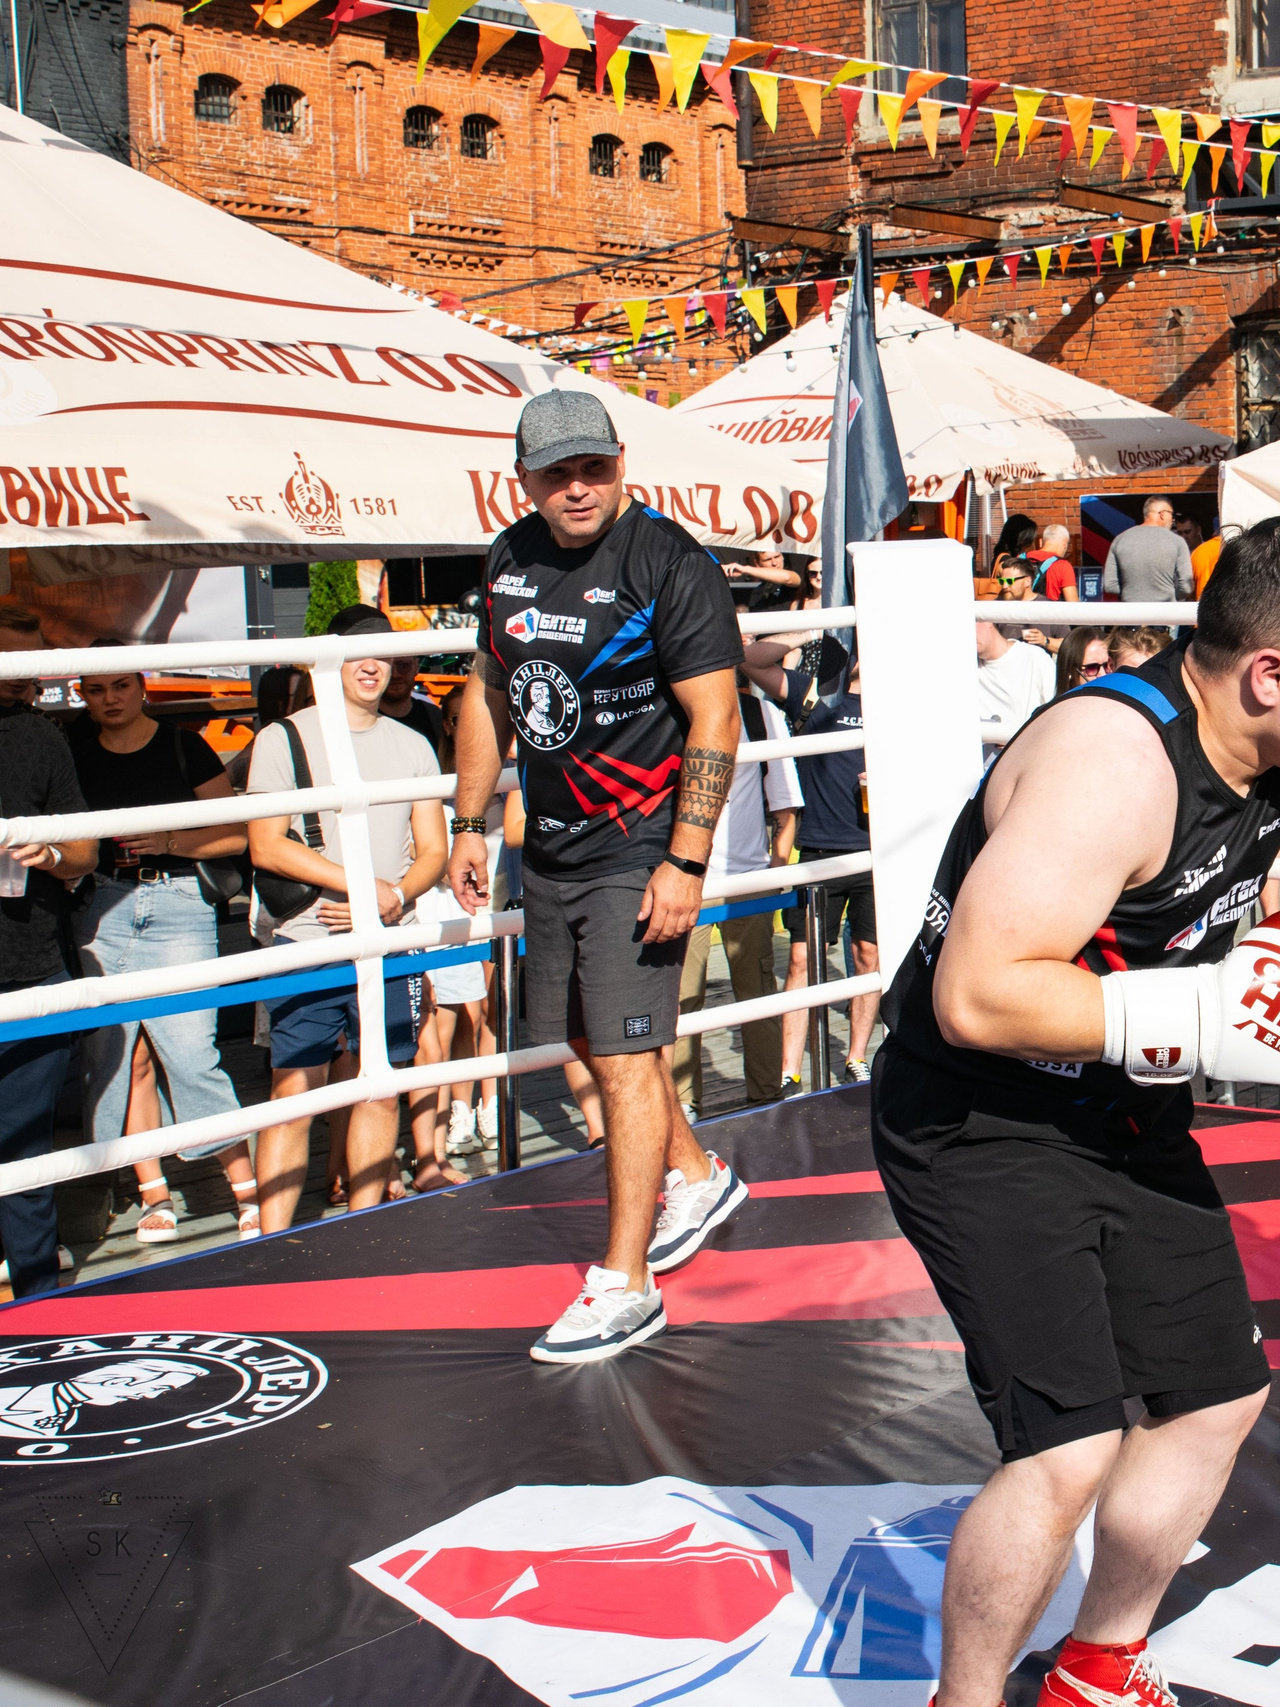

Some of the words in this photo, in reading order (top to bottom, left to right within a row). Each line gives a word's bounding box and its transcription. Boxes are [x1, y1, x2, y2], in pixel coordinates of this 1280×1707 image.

[375, 346, 523, 398] 0.0
[708, 408, 833, 445] ШŎВИ
[0, 466, 151, 528] ВИЦЕ
[226, 495, 277, 515] EST.
[349, 497, 398, 517] 1581
[464, 470, 738, 534] KRINZ
[742, 485, 818, 544] 0.0
[539, 613, 588, 635] БИТВА
[537, 630, 585, 645] ОБЩЕПИТОВ
[511, 663, 577, 715] КАНЦЛЕРЪ
[594, 682, 655, 705] КРУТОЯР
[616, 703, 656, 721] LADOGA
[523, 726, 566, 746] 2010
[1263, 1033, 1276, 1046] BE
